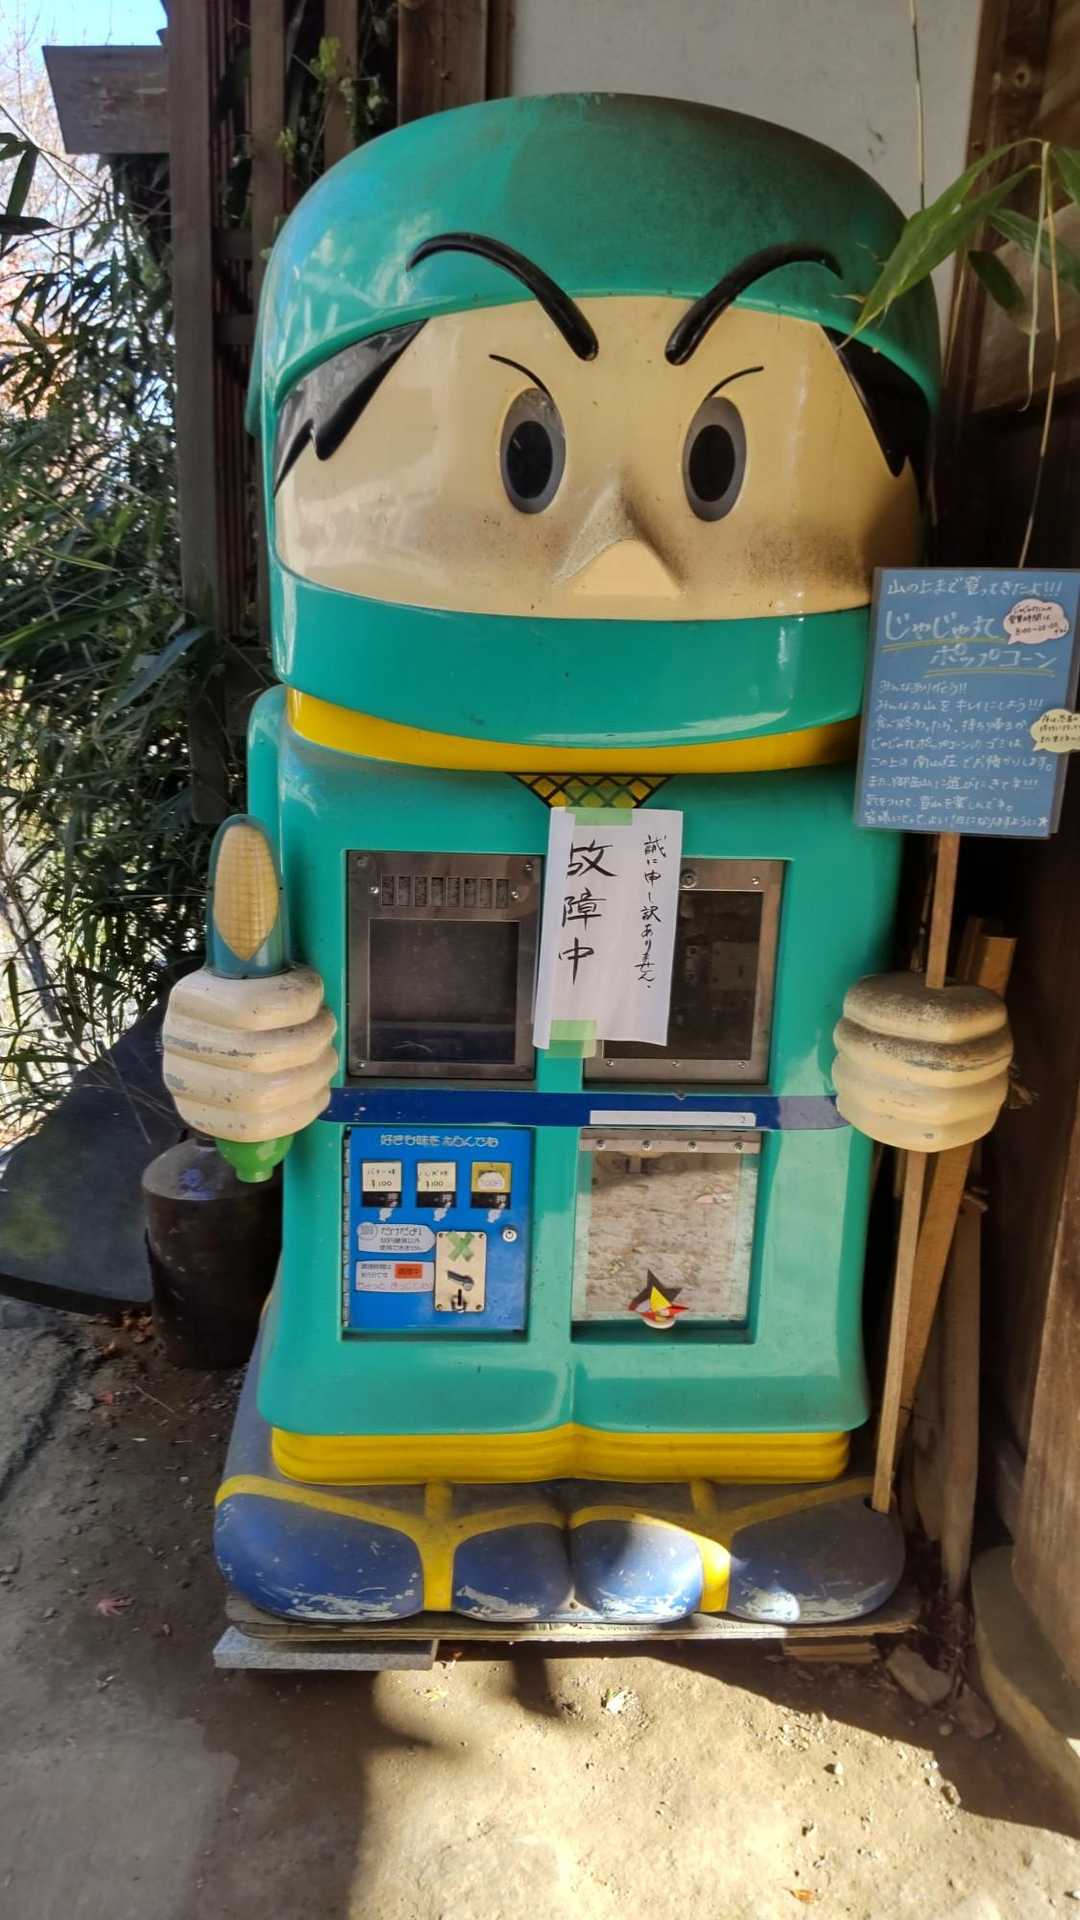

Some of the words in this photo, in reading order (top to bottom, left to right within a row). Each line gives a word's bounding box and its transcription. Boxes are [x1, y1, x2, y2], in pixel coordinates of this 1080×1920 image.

[929, 643, 1058, 669] ポップコーン
[558, 840, 618, 985] 故障中
